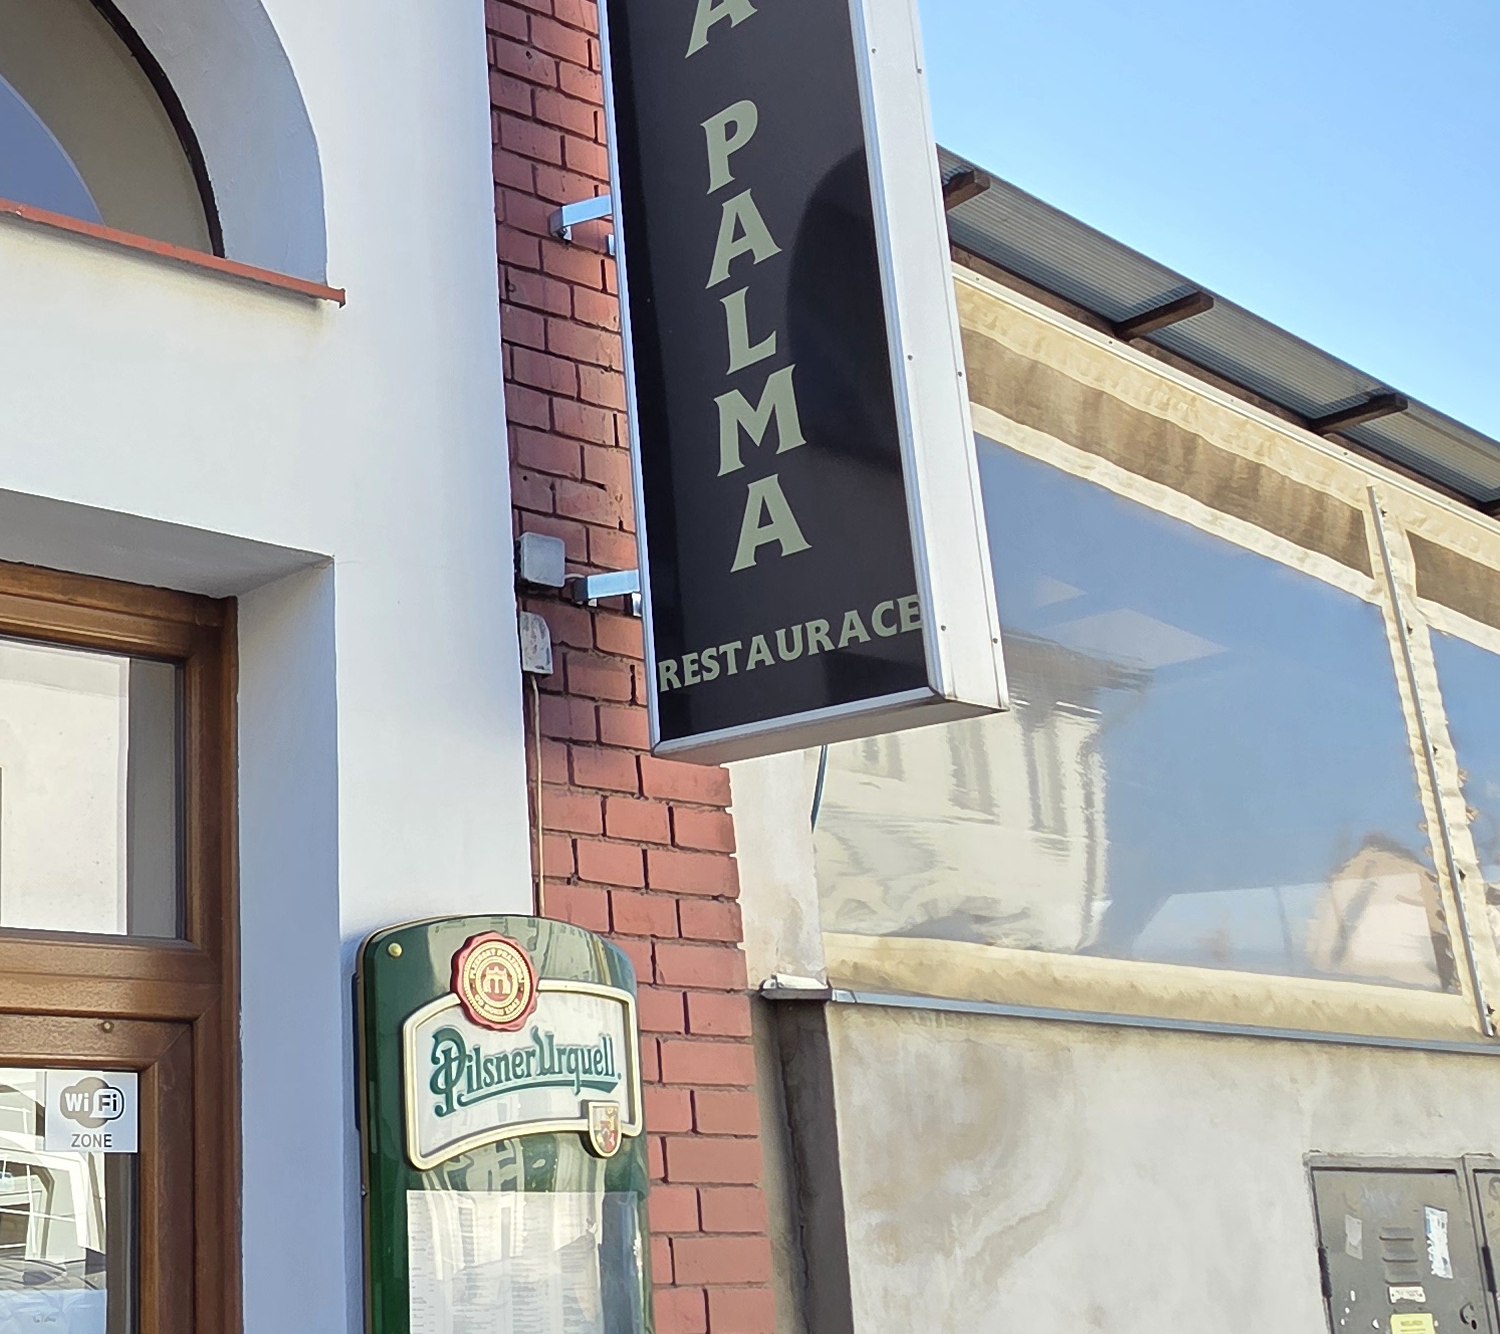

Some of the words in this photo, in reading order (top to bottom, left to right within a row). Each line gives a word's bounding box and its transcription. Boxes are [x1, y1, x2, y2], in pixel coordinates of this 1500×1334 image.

[700, 99, 812, 573] PALMA
[658, 594, 924, 693] RESTAURACE
[429, 1027, 537, 1117] Pilsner
[532, 1026, 616, 1096] Urquell
[71, 1133, 112, 1147] ZONE
